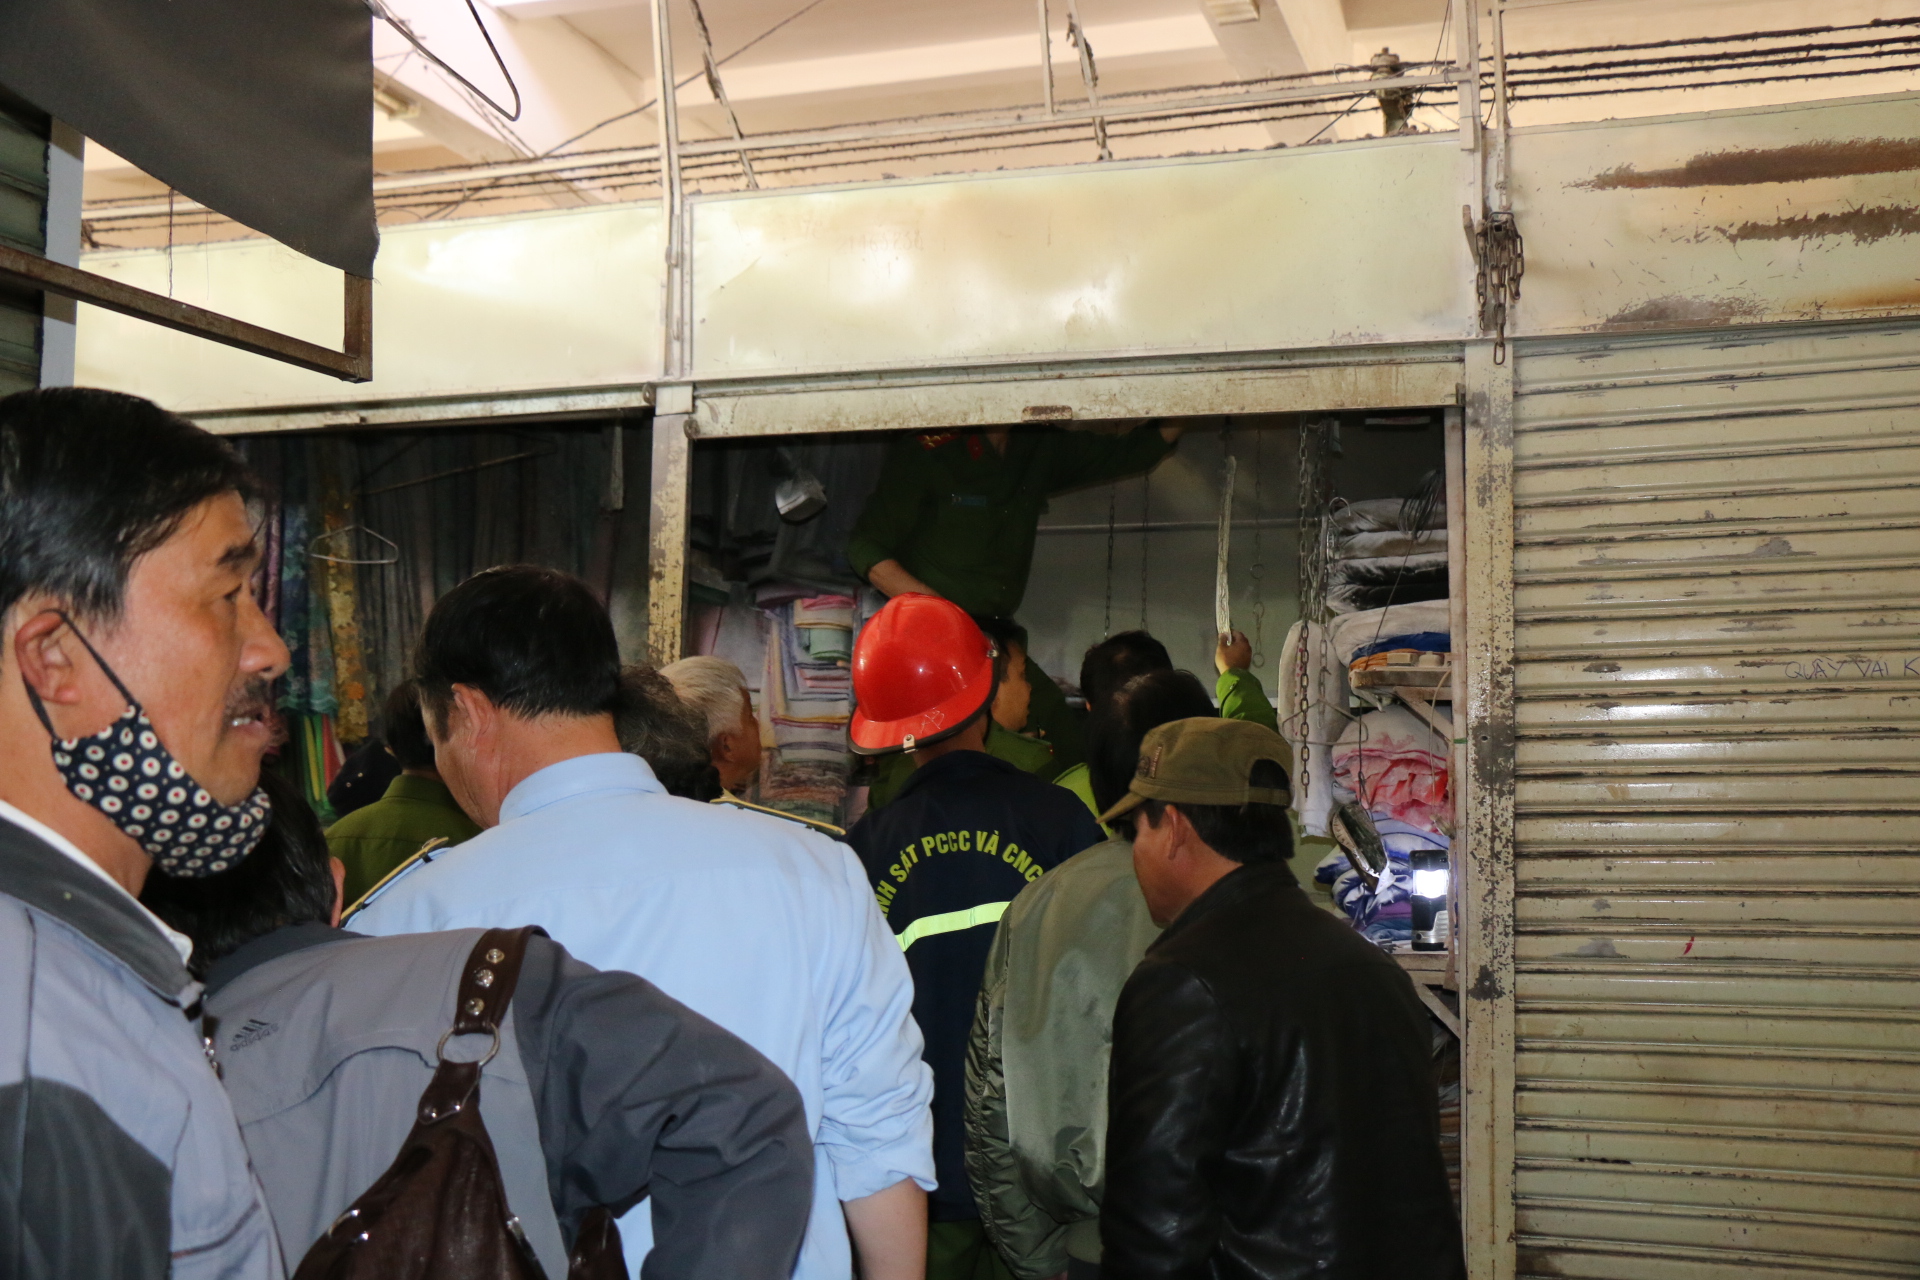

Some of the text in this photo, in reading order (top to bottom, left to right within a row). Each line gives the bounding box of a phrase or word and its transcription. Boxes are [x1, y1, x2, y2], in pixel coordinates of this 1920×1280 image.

[876, 880, 897, 918] NH
[890, 844, 919, 883] SÁT
[921, 830, 971, 857] PCCC
[976, 830, 1000, 856] VÀ
